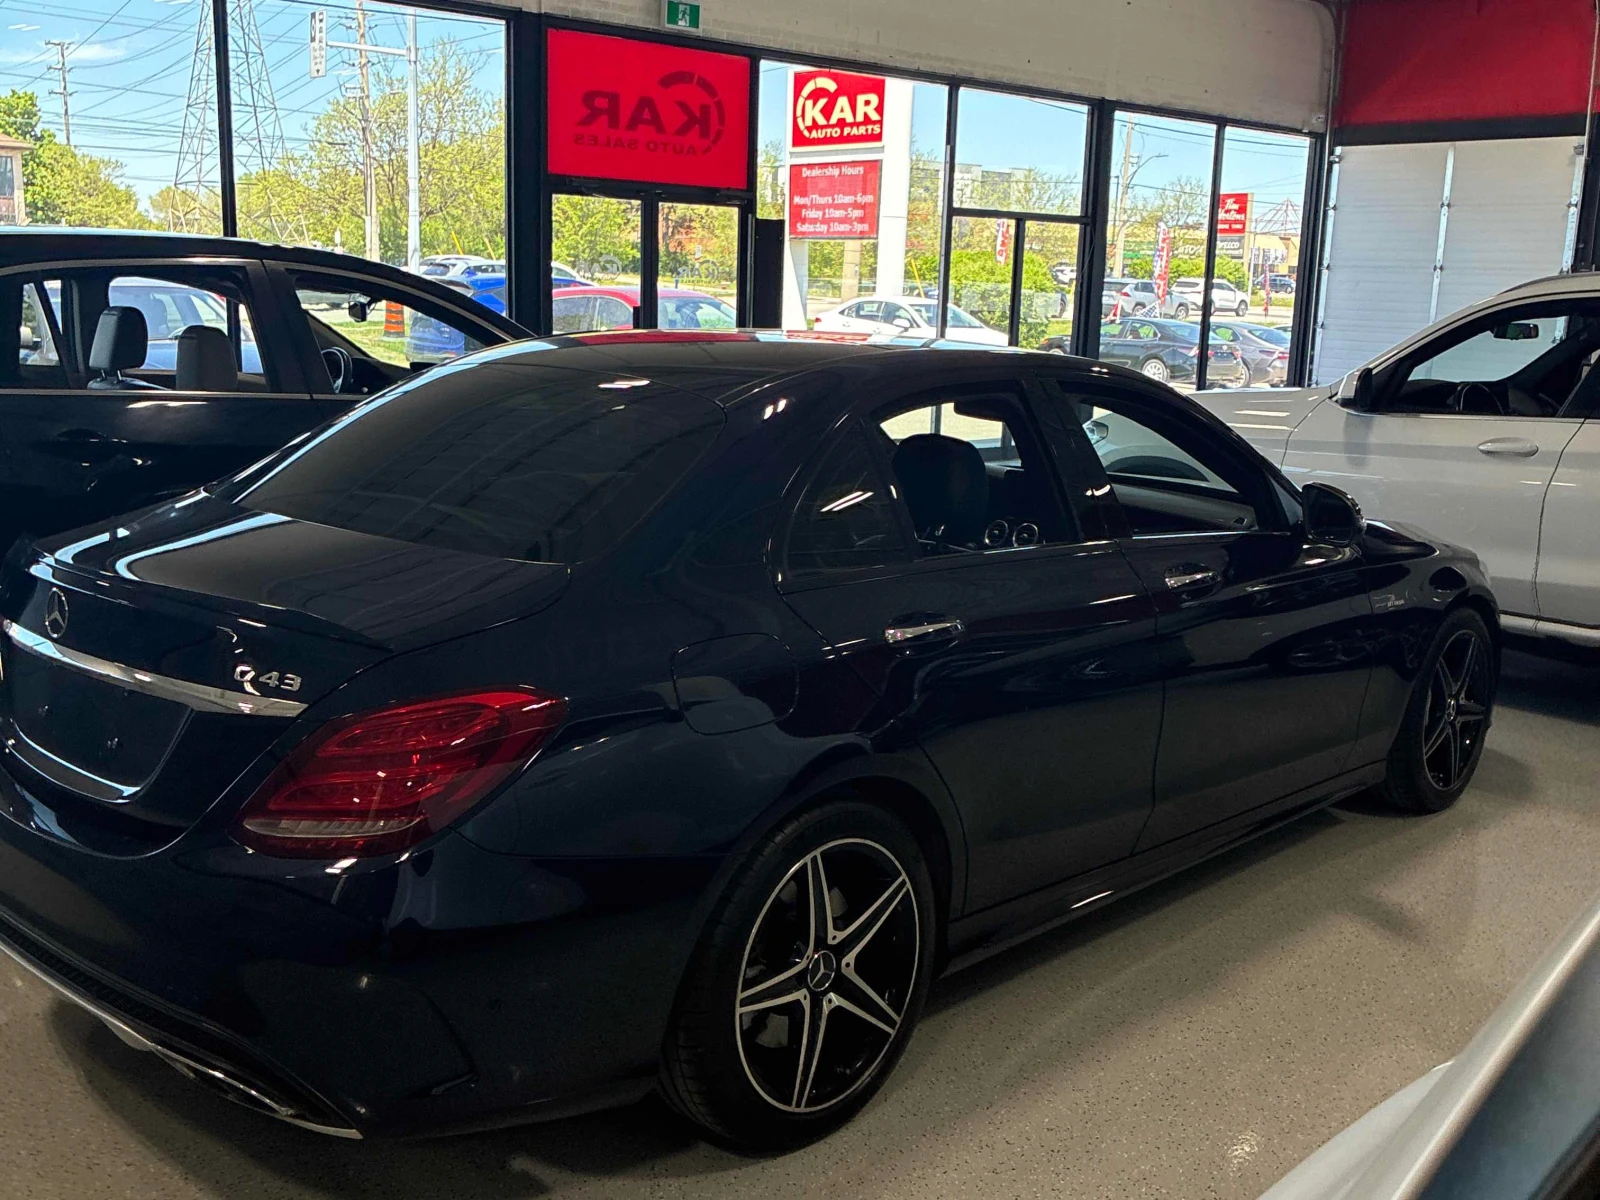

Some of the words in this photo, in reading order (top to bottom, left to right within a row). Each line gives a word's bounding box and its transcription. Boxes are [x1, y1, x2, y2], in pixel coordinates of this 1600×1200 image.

[804, 93, 881, 127] KAR
[810, 128, 840, 139] AUTO
[843, 124, 881, 136] PARTS
[802, 166, 840, 178] Dealership
[841, 165, 864, 175] Hours
[793, 194, 832, 206] Mon/Thurs
[834, 193, 874, 205] 10am-6pm
[801, 208, 823, 220] Friday
[825, 207, 864, 219] 10am-5pm
[797, 222, 828, 234] Saturday
[830, 221, 869, 234] 10am-3pm
[259, 671, 302, 692] 43
